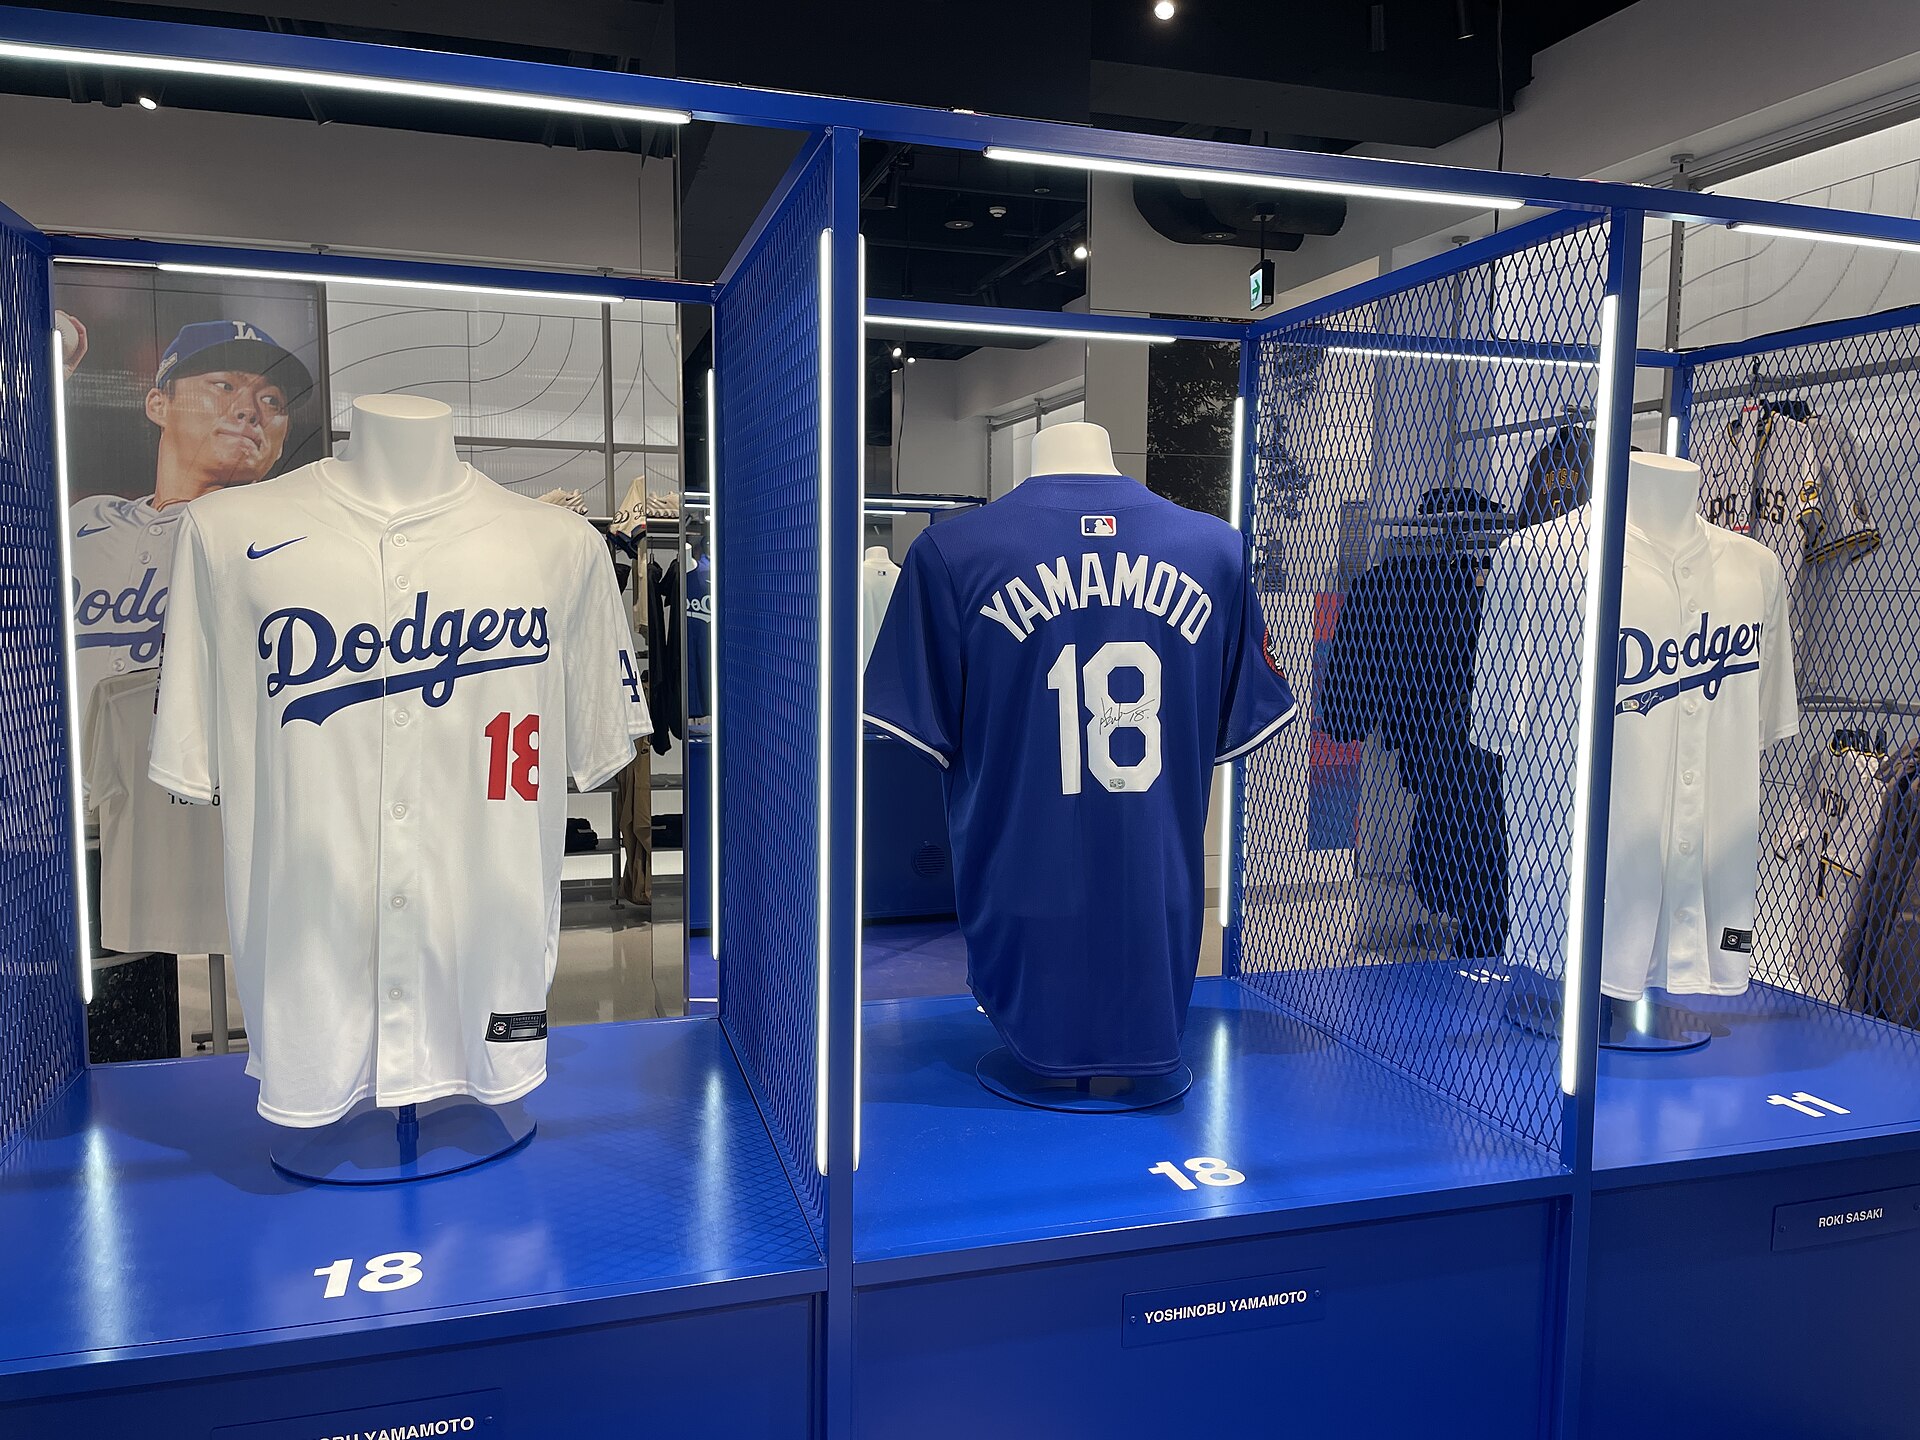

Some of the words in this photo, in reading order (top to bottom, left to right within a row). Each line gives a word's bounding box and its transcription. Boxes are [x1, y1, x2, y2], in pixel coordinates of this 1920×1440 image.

[71, 568, 168, 663] odg
[979, 552, 1213, 645] YAMAMOTO
[258, 591, 550, 714] Dodgers
[1047, 641, 1162, 795] 18
[484, 711, 540, 802] 18
[1766, 1091, 1851, 1118] 11
[1147, 1157, 1246, 1191] 18
[1818, 1213, 1844, 1228] ROKI
[1845, 1207, 1883, 1224] SASAKI
[313, 1251, 423, 1299] 18
[1144, 1301, 1226, 1324] YOSHINOBU
[1229, 1290, 1307, 1312] YAMAMOTO
[364, 1416, 475, 1440] YAMAMOTO
